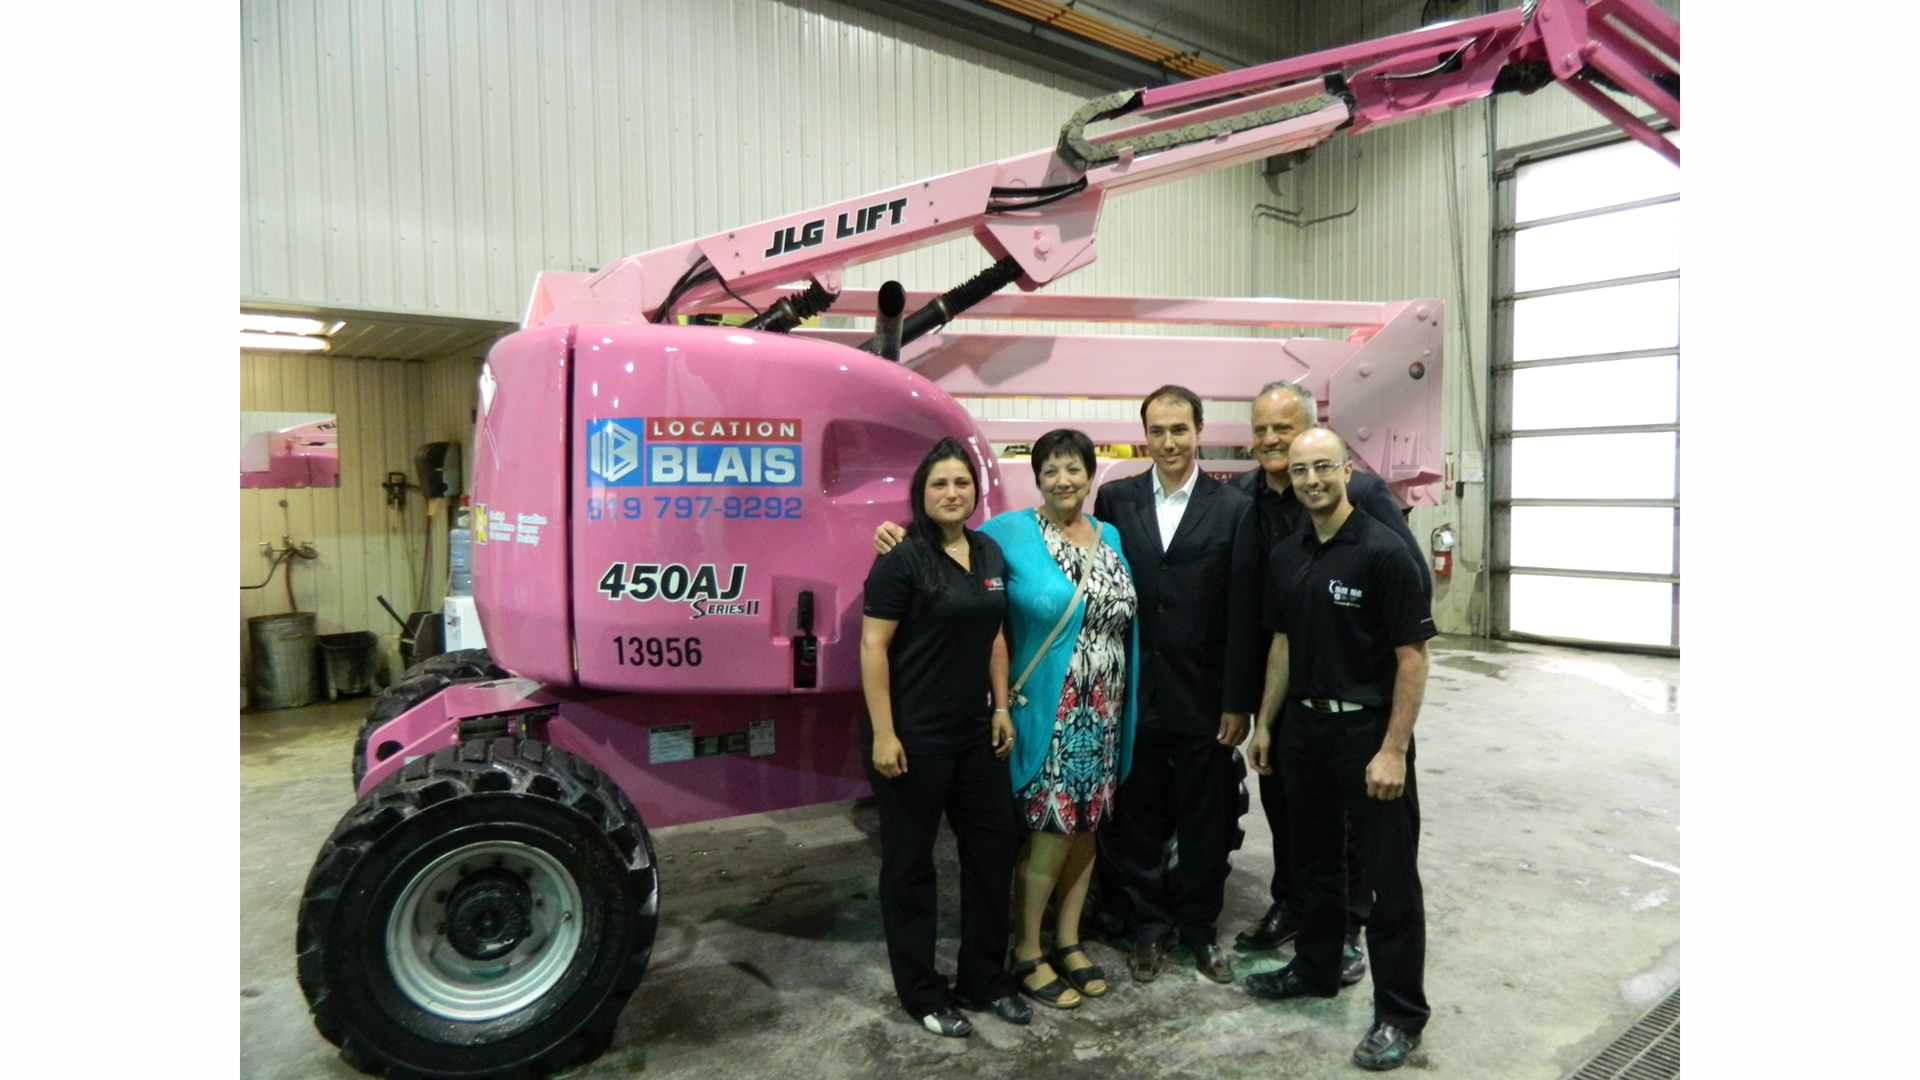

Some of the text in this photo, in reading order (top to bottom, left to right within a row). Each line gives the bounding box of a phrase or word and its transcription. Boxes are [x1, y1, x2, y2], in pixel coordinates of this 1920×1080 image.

[764, 196, 908, 259] JLG LIFT
[653, 421, 795, 437] LOCATION
[652, 447, 796, 483] BLAIS
[587, 496, 802, 520] 819 797-9292
[598, 562, 747, 602] 450AJ
[613, 636, 702, 667] 13956
